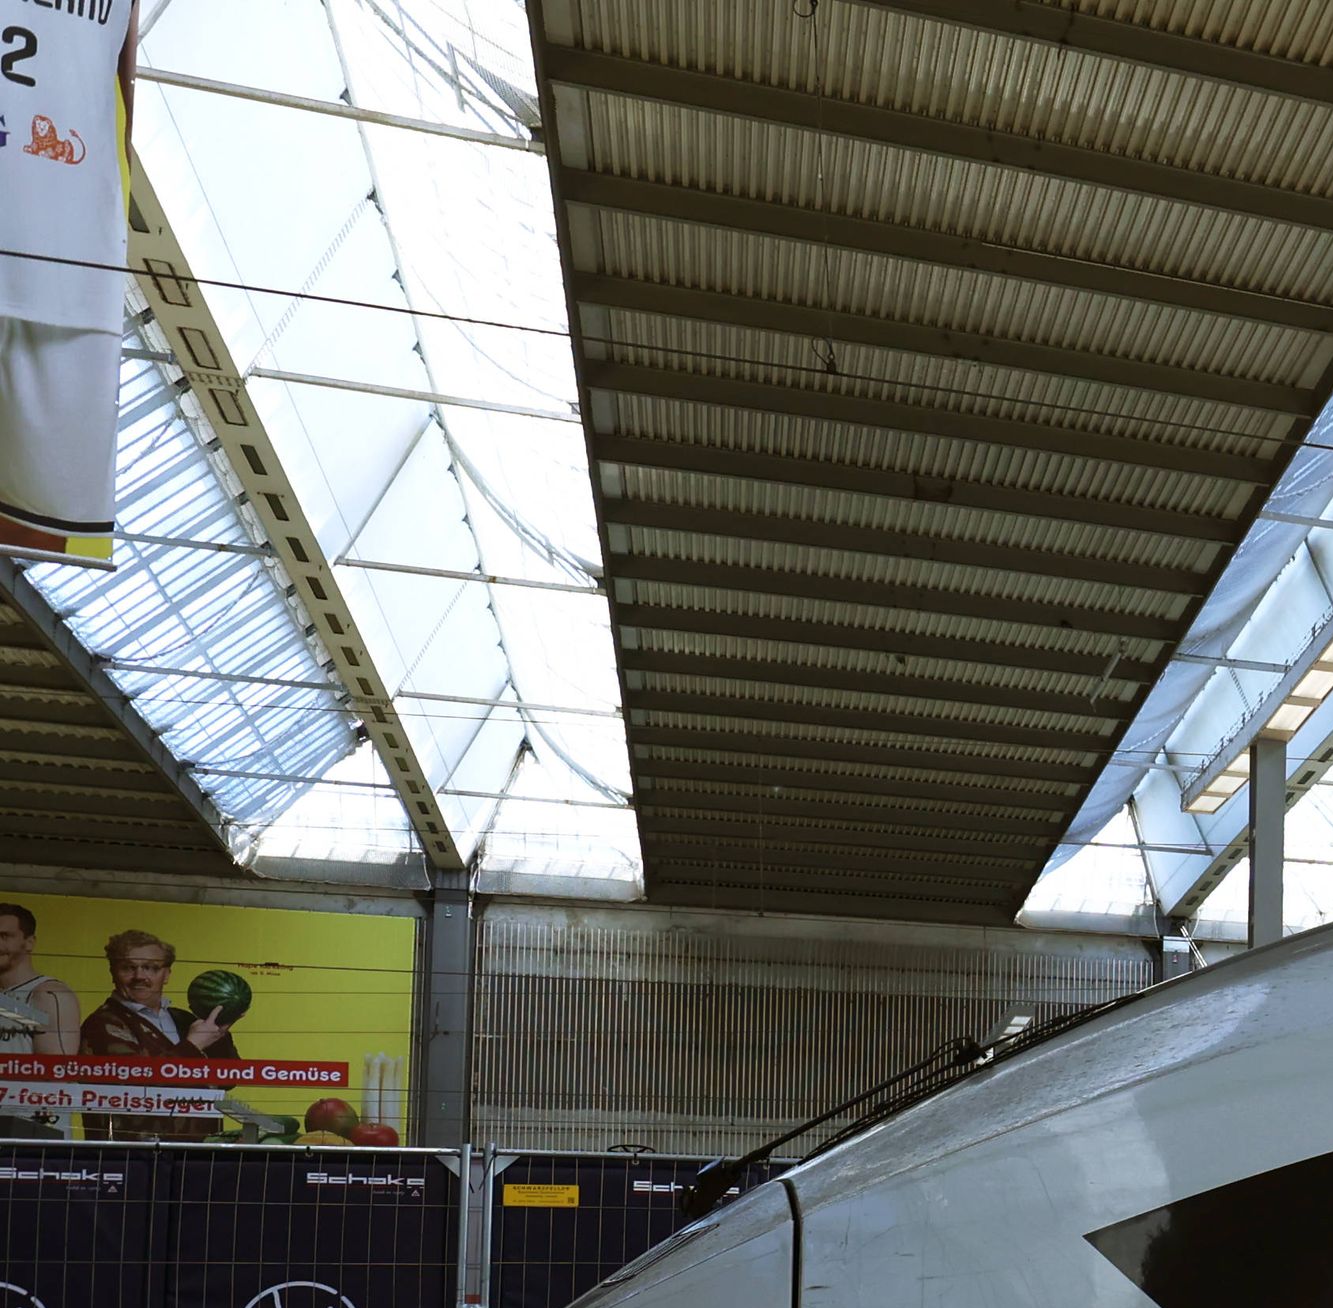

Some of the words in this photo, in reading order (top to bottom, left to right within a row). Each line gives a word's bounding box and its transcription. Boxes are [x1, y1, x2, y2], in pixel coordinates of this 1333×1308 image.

[1, 26, 37, 87] 2
[53, 1061, 154, 1080] günstiges
[160, 1063, 210, 1079] Obst
[217, 1066, 254, 1080] und
[261, 1065, 342, 1082] Gemüse
[82, 1089, 215, 1114] Preissieger
